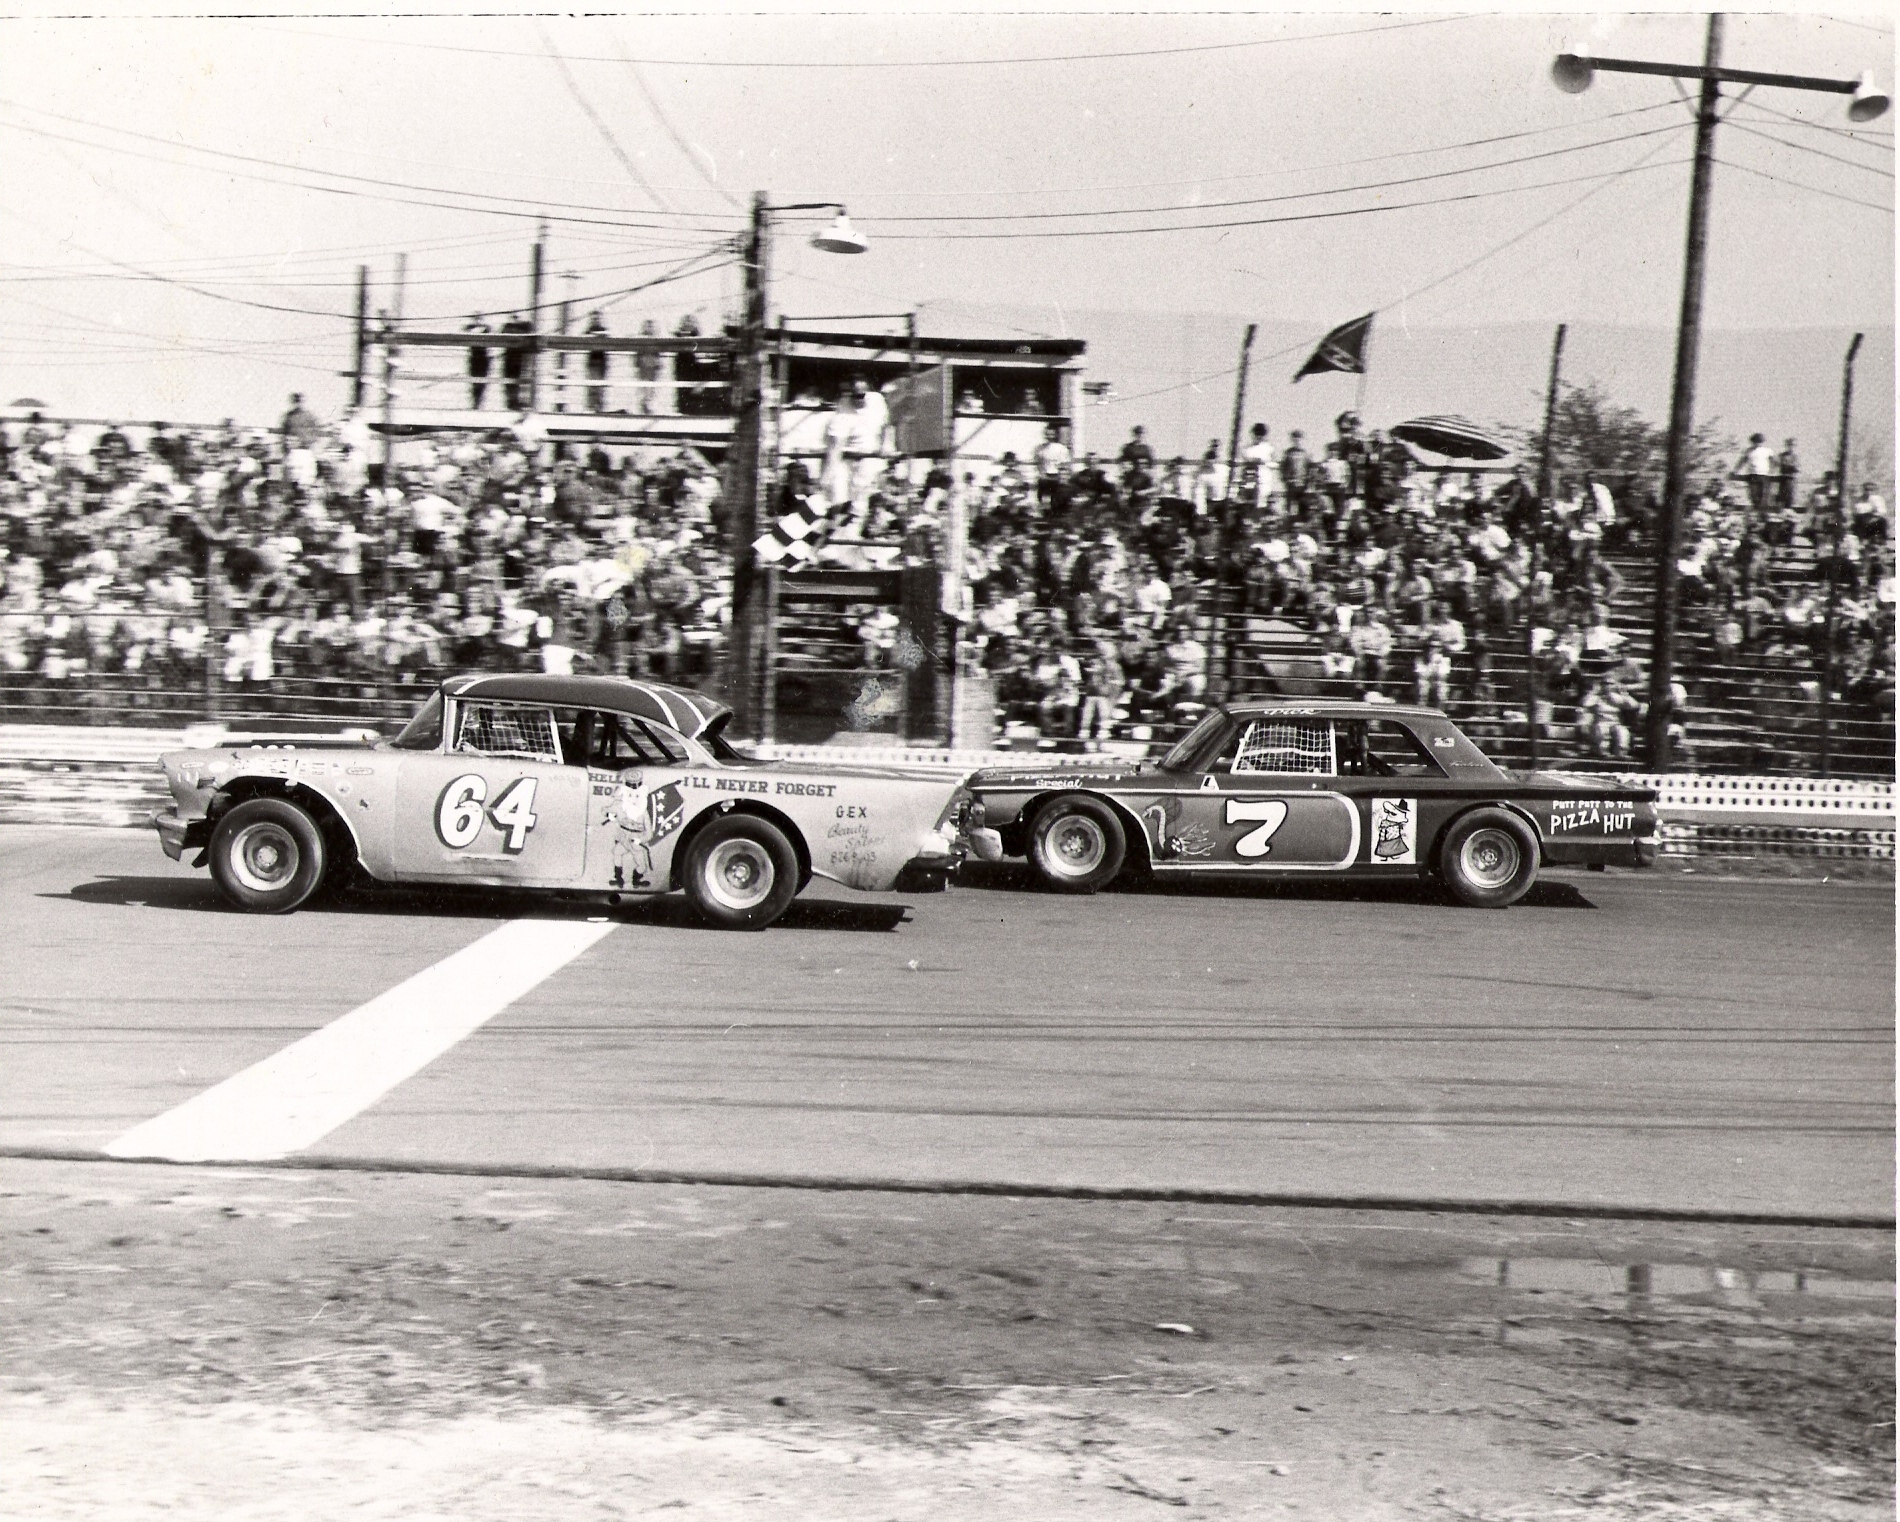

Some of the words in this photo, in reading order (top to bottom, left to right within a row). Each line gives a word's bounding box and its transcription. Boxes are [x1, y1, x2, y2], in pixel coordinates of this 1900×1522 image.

[588, 773, 623, 784] HELL
[1035, 779, 1083, 789] Special
[715, 778, 769, 794] NEVER
[775, 781, 837, 797] FORGET
[836, 805, 867, 818] GEX
[1552, 800, 1576, 810] PUTT
[1578, 800, 1601, 809] PUTT
[1604, 801, 1615, 809] TO
[1617, 801, 1634, 809] THE
[433, 773, 539, 855] 64
[1550, 808, 1601, 835] PIZZA
[1603, 813, 1636, 834] HUT
[1224, 798, 1289, 858] 7
